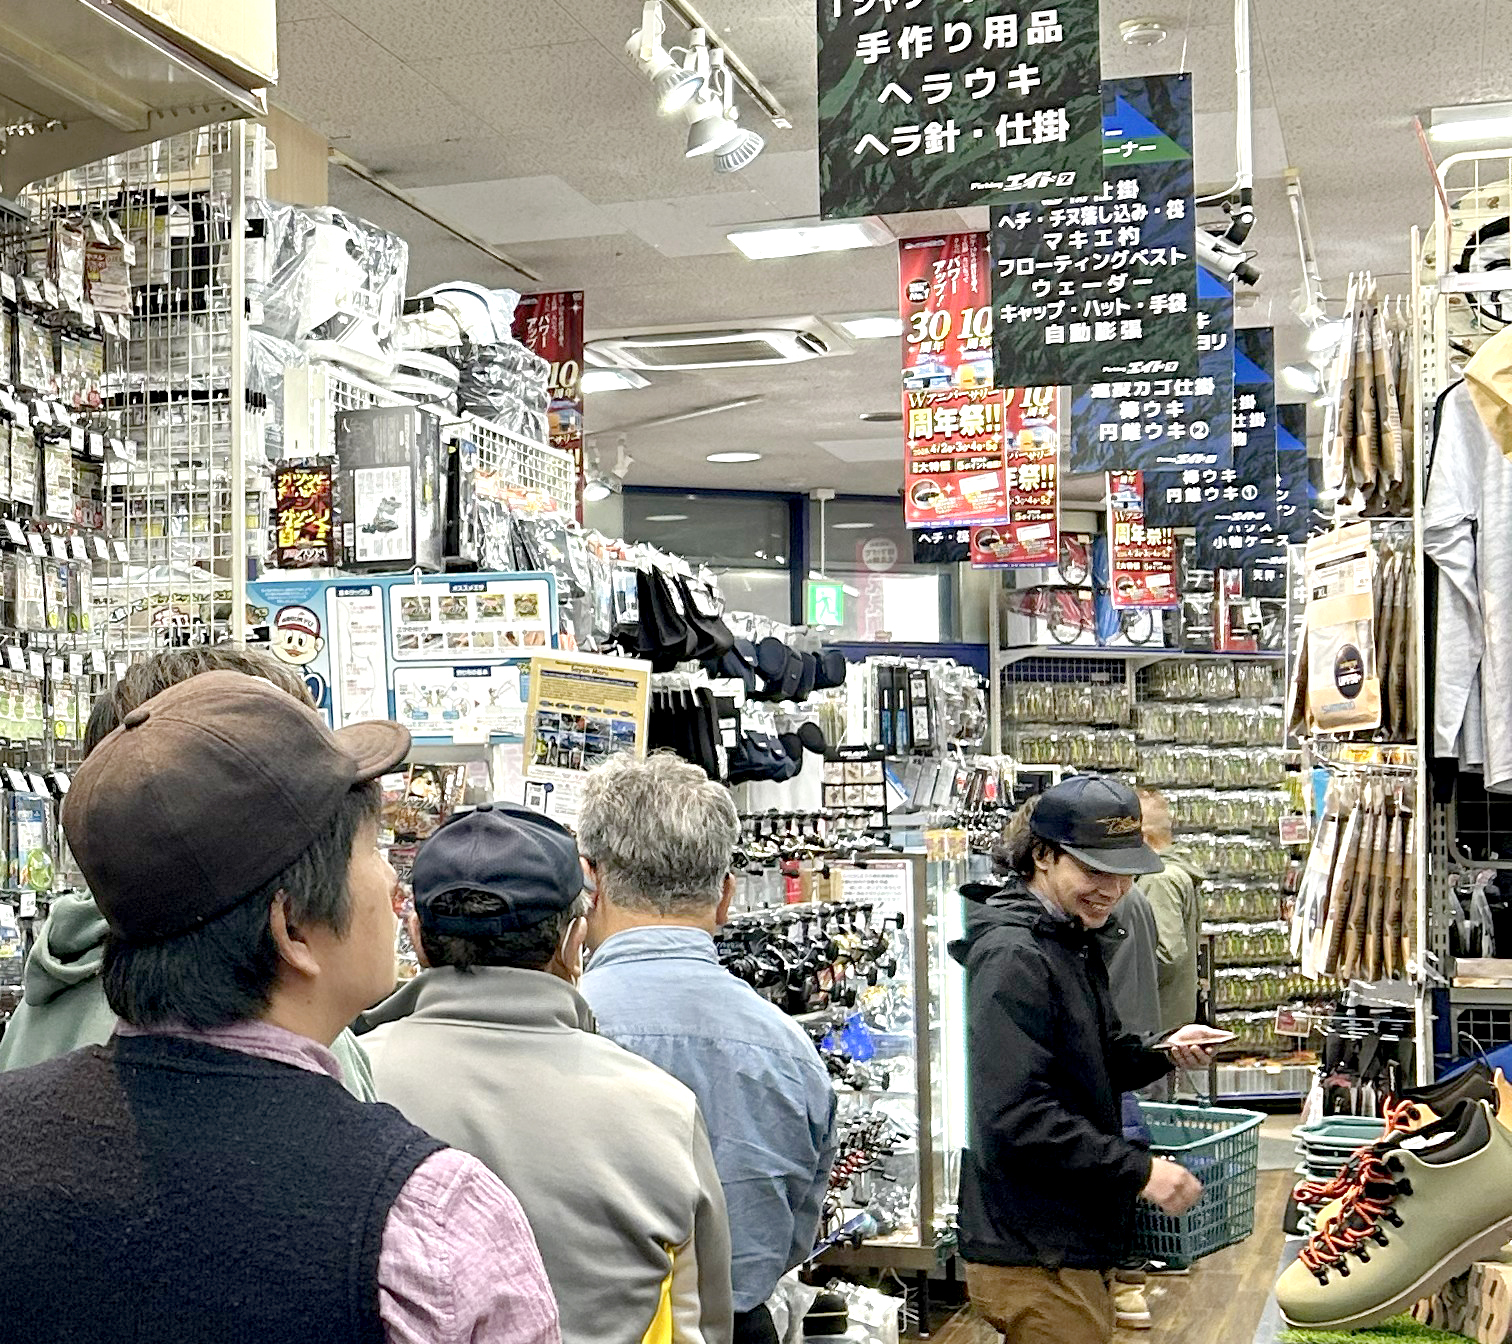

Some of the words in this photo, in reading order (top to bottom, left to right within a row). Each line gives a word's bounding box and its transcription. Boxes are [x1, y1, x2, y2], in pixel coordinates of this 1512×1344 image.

[856, 11, 1063, 65] 手作り用品
[877, 63, 1042, 106] ヘラウキ
[853, 109, 1071, 158] ヘラ針・仕掛
[997, 246, 1187, 278] フローティングベスト
[1031, 272, 1154, 298] ウェーダー
[956, 306, 993, 340] 10
[999, 292, 1188, 324] キャップ・ハット・手袋
[906, 308, 952, 344] 30
[1044, 319, 1143, 346] 自動膨張
